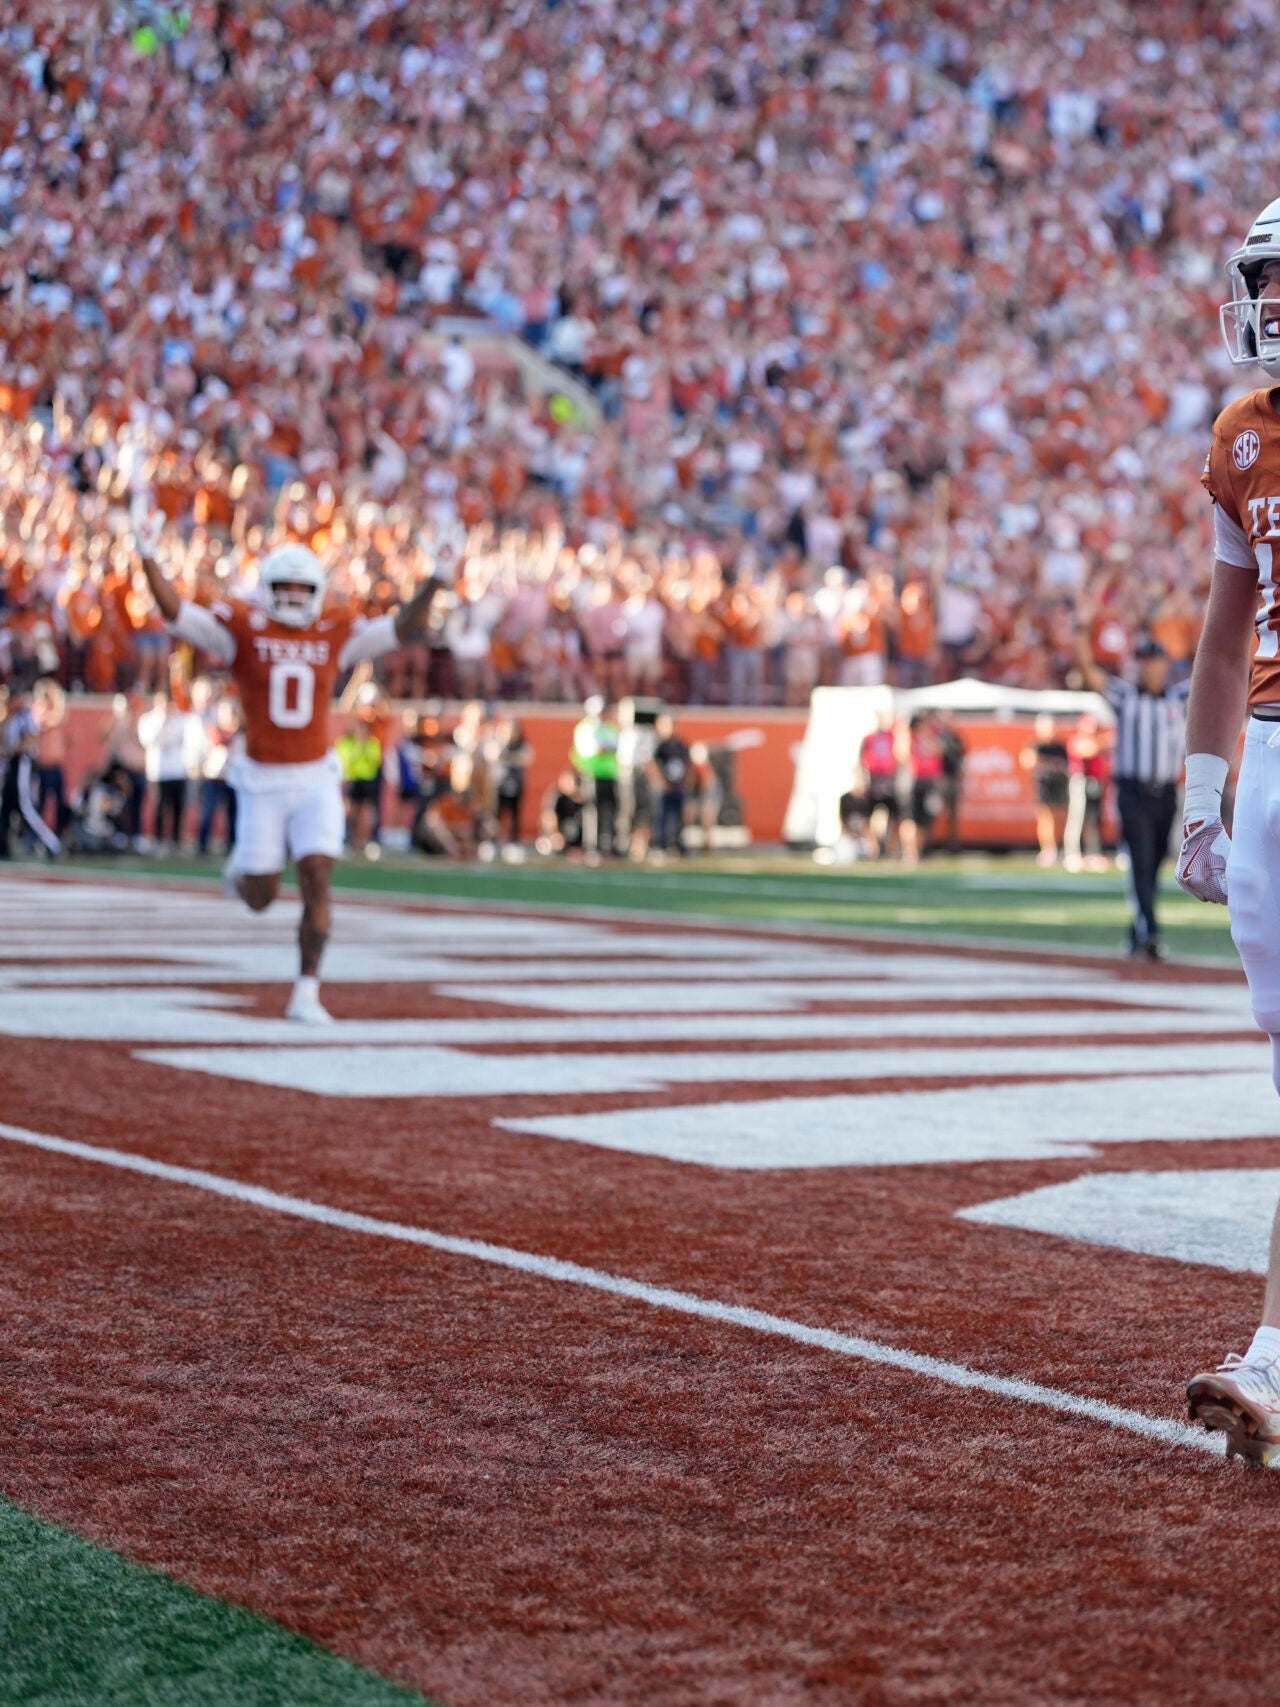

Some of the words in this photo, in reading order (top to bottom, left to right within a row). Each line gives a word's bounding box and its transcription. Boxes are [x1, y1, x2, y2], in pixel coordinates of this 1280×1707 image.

[1235, 432, 1258, 468] SEC
[253, 637, 330, 666] TEXAS
[268, 660, 315, 730] 0
